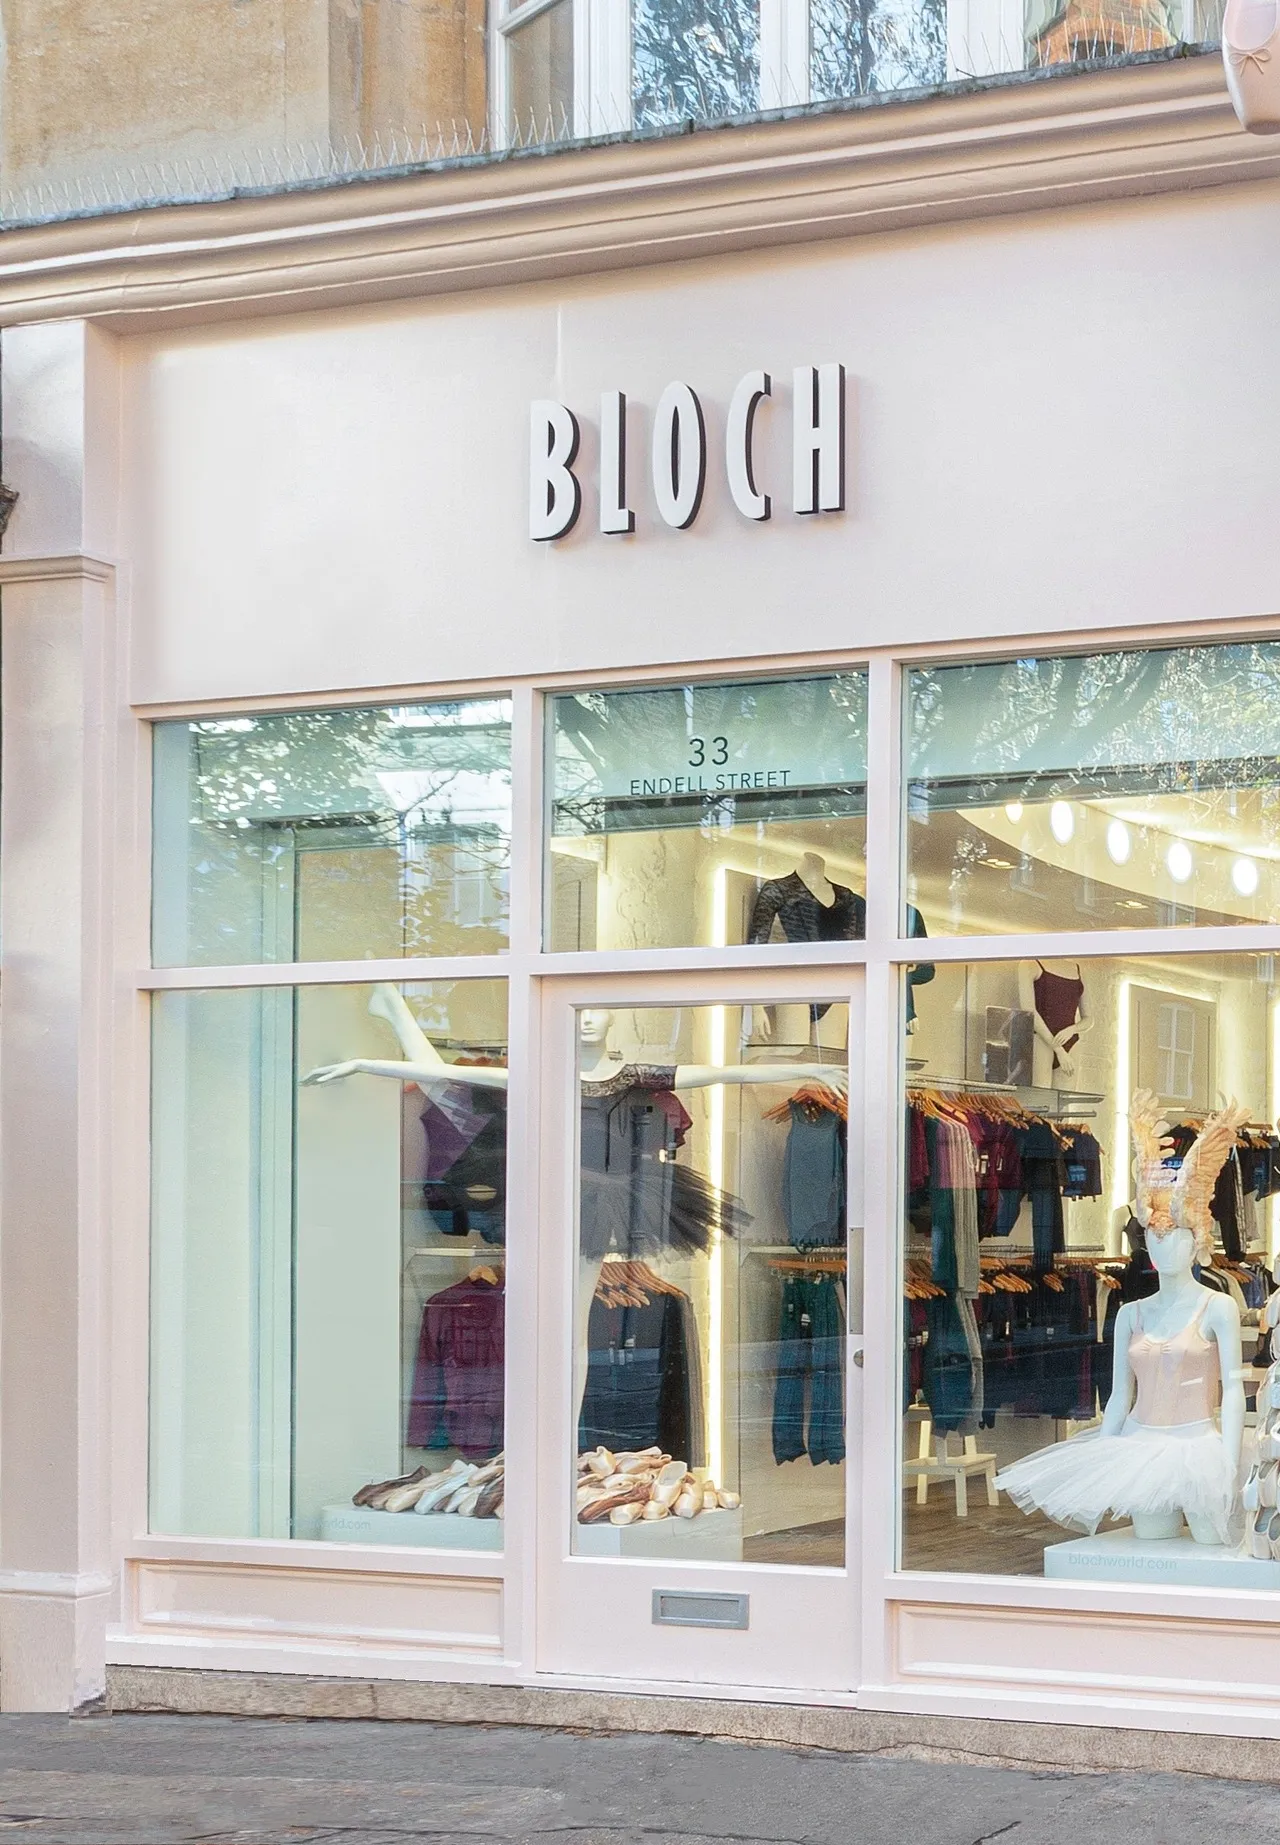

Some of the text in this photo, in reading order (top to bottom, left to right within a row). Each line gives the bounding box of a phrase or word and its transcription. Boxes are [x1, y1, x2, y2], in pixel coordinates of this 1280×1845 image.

[530, 363, 846, 542] BLOCH
[688, 736, 728, 767] 33
[630, 770, 791, 796] ENDELL STREET
[1068, 1552, 1178, 1570] blochworld.com
